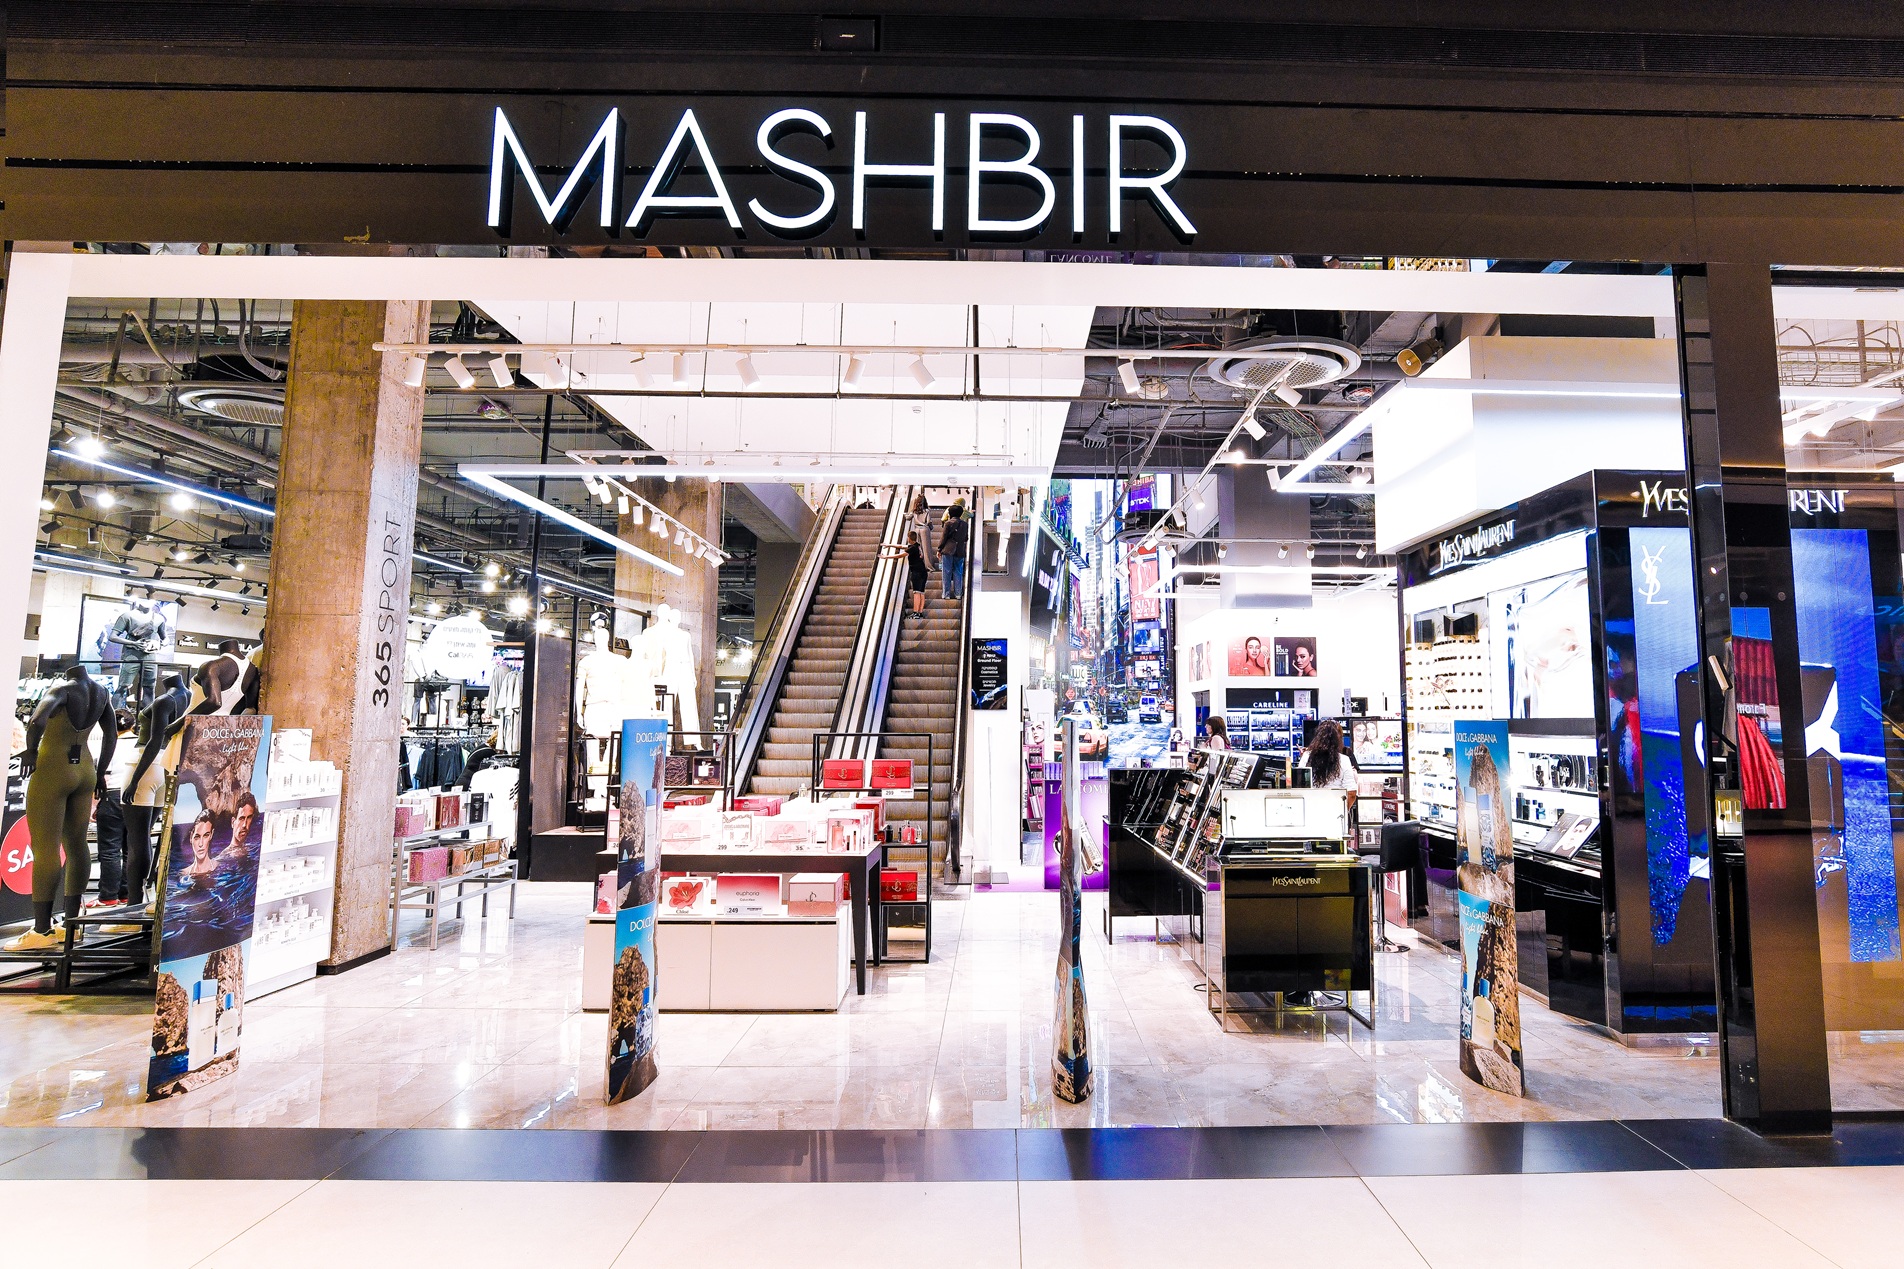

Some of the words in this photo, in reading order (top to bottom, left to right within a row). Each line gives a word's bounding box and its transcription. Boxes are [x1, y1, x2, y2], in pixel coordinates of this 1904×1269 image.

[487, 106, 1198, 235] MASHBIR
[1790, 489, 1849, 515] RENT
[377, 511, 401, 634] SPORT
[1638, 545, 1669, 605] YSL
[372, 641, 392, 708] 365
[203, 729, 229, 738] DOLCE
[234, 729, 265, 738] GABBANA
[636, 732, 652, 742] DOLCE
[1470, 732, 1497, 743] GABBANA
[1049, 783, 1108, 795] LAÔM
[7, 844, 35, 873] SA
[1473, 909, 1505, 928] GABBANA
